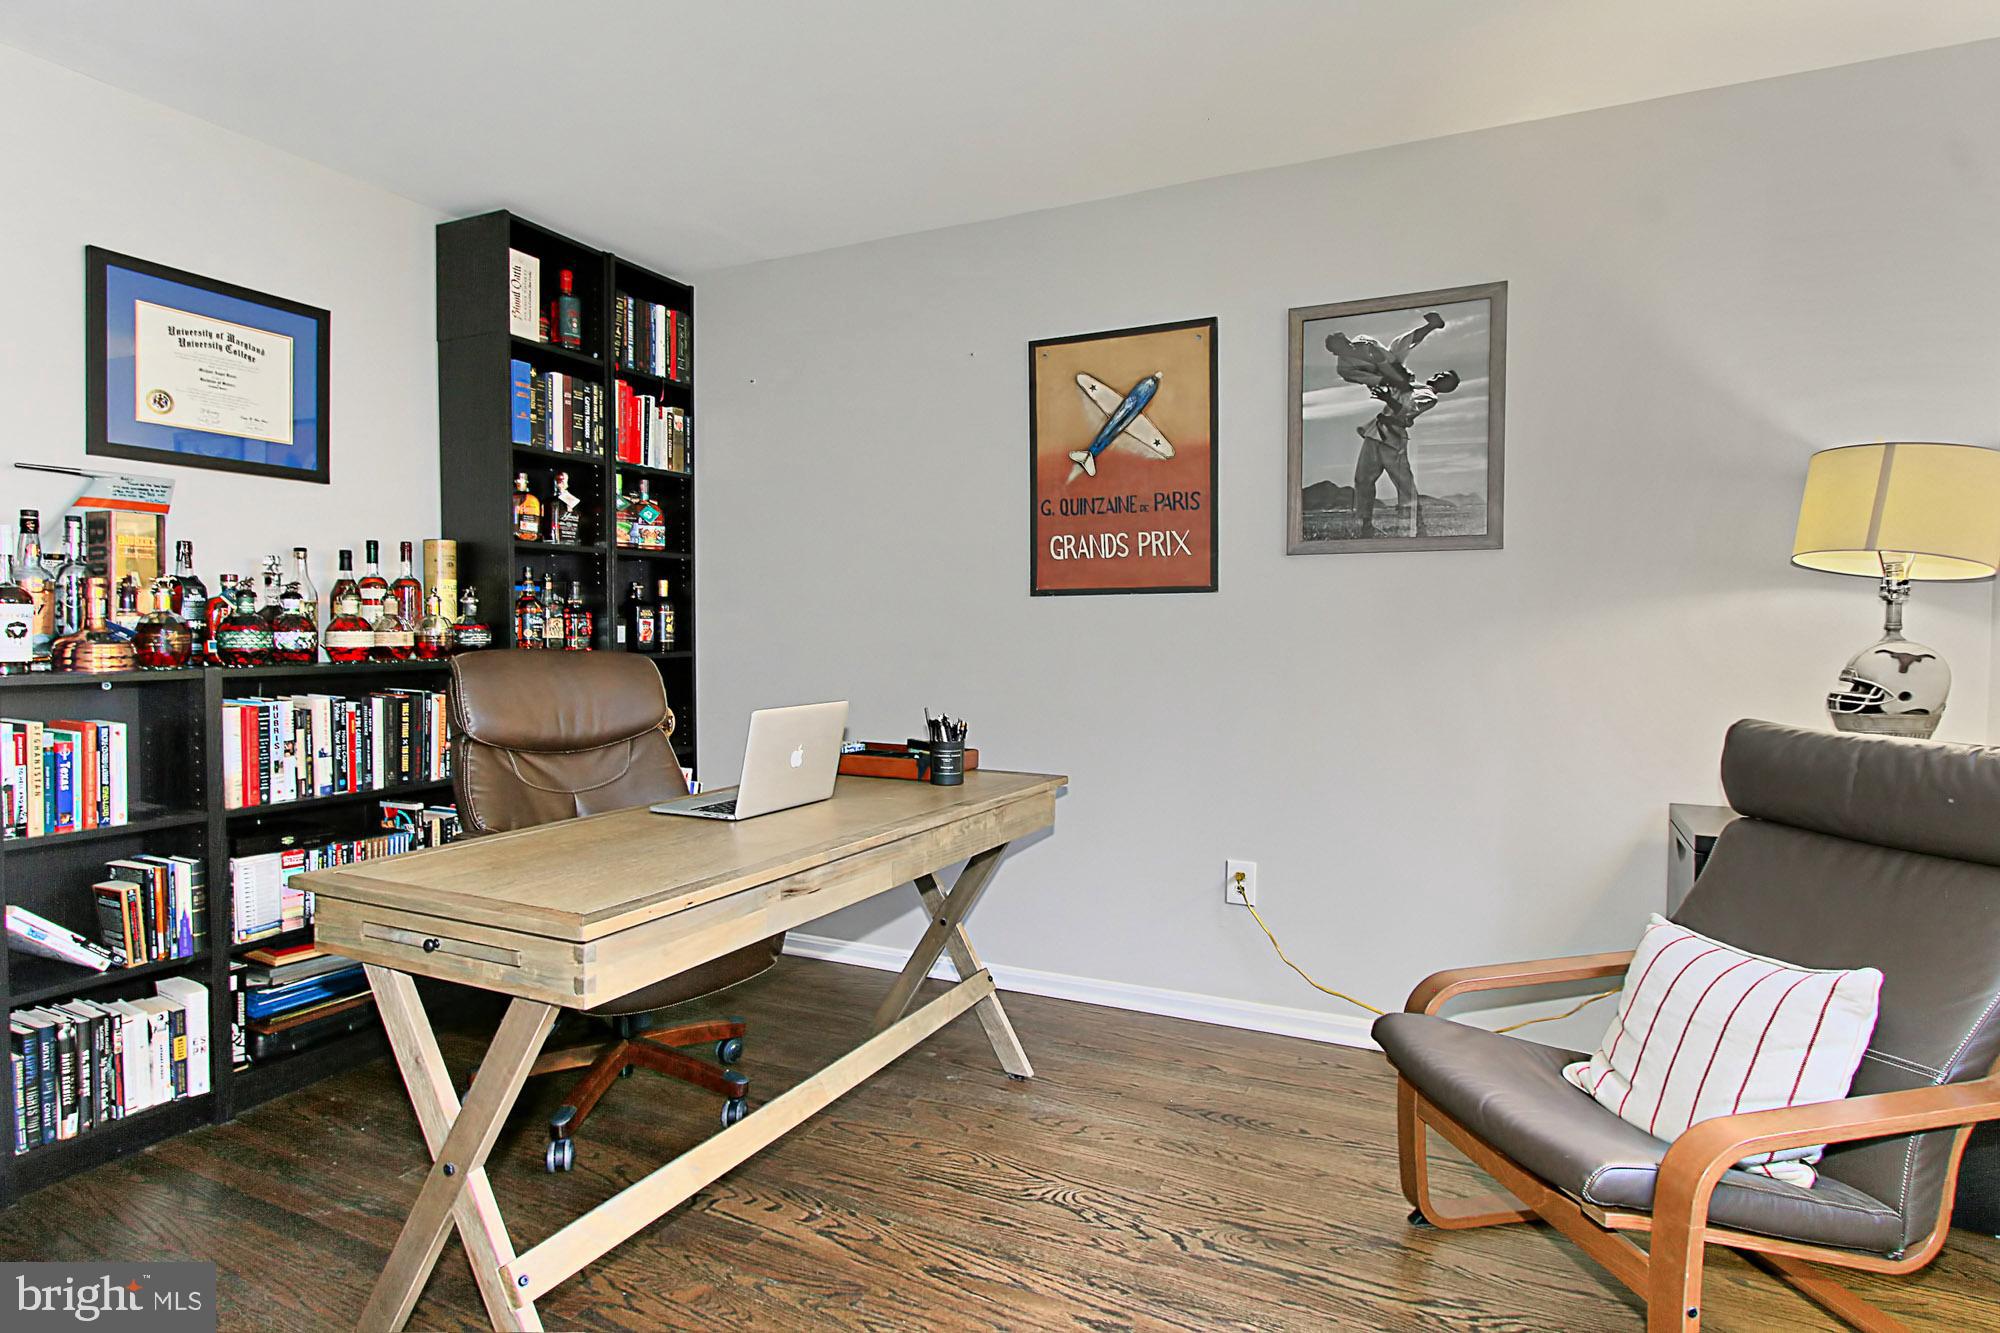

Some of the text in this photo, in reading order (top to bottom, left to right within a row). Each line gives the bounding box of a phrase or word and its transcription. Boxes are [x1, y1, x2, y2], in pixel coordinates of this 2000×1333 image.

[511, 266, 521, 320] Blood Oath
[168, 325, 265, 356] University of Maryland
[178, 338, 223, 353] University
[226, 344, 256, 364] College
[1041, 491, 1200, 516] G. QUINZAINE DE PARIS
[1050, 530, 1192, 560] GRANDS PRIX
[60, 761, 71, 791] Texas
[62, 1053, 70, 1074] DAVID
[26, 1086, 40, 1133] LIGHTS OUT
